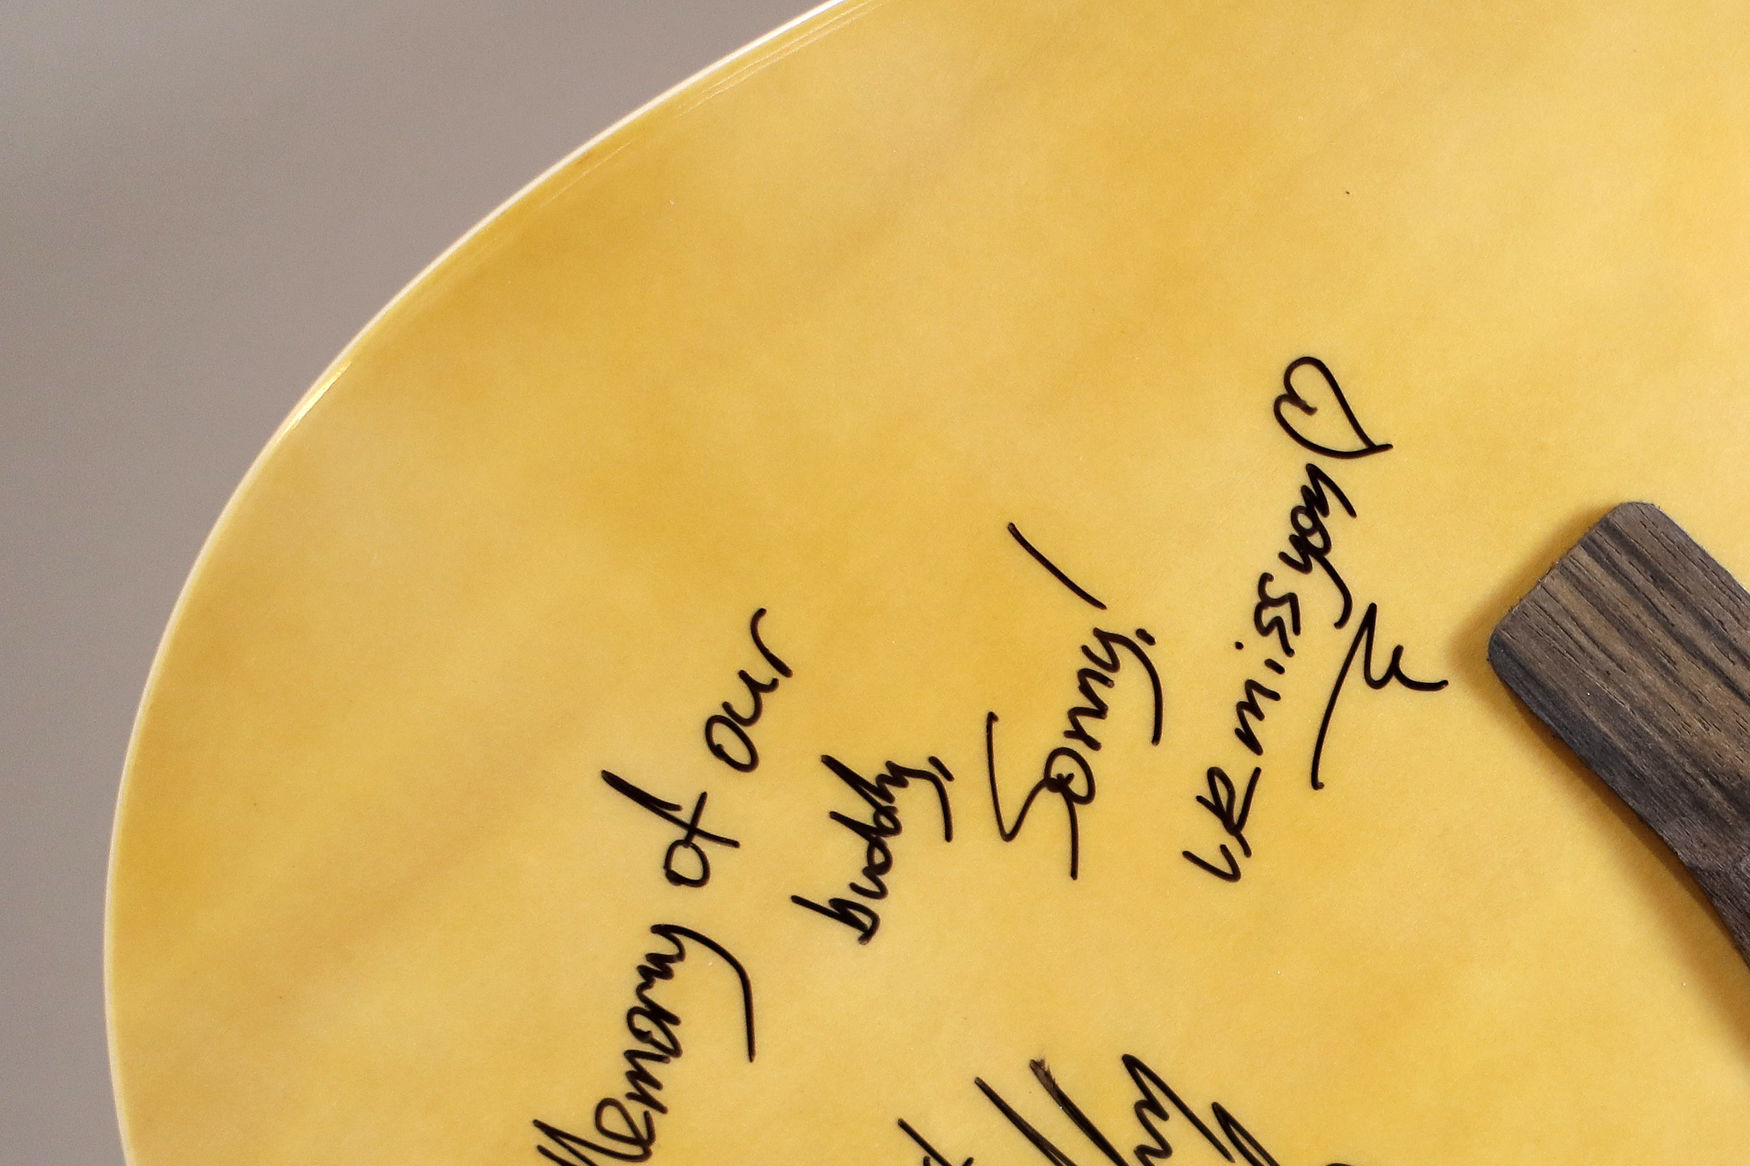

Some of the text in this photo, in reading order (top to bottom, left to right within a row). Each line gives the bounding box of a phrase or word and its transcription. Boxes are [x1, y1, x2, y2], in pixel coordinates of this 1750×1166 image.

[601, 770, 739, 887] of
[705, 608, 791, 772] our
[986, 523, 1162, 880] Sonny!
[1235, 572, 1300, 755] miss
[1279, 463, 1356, 628] you
